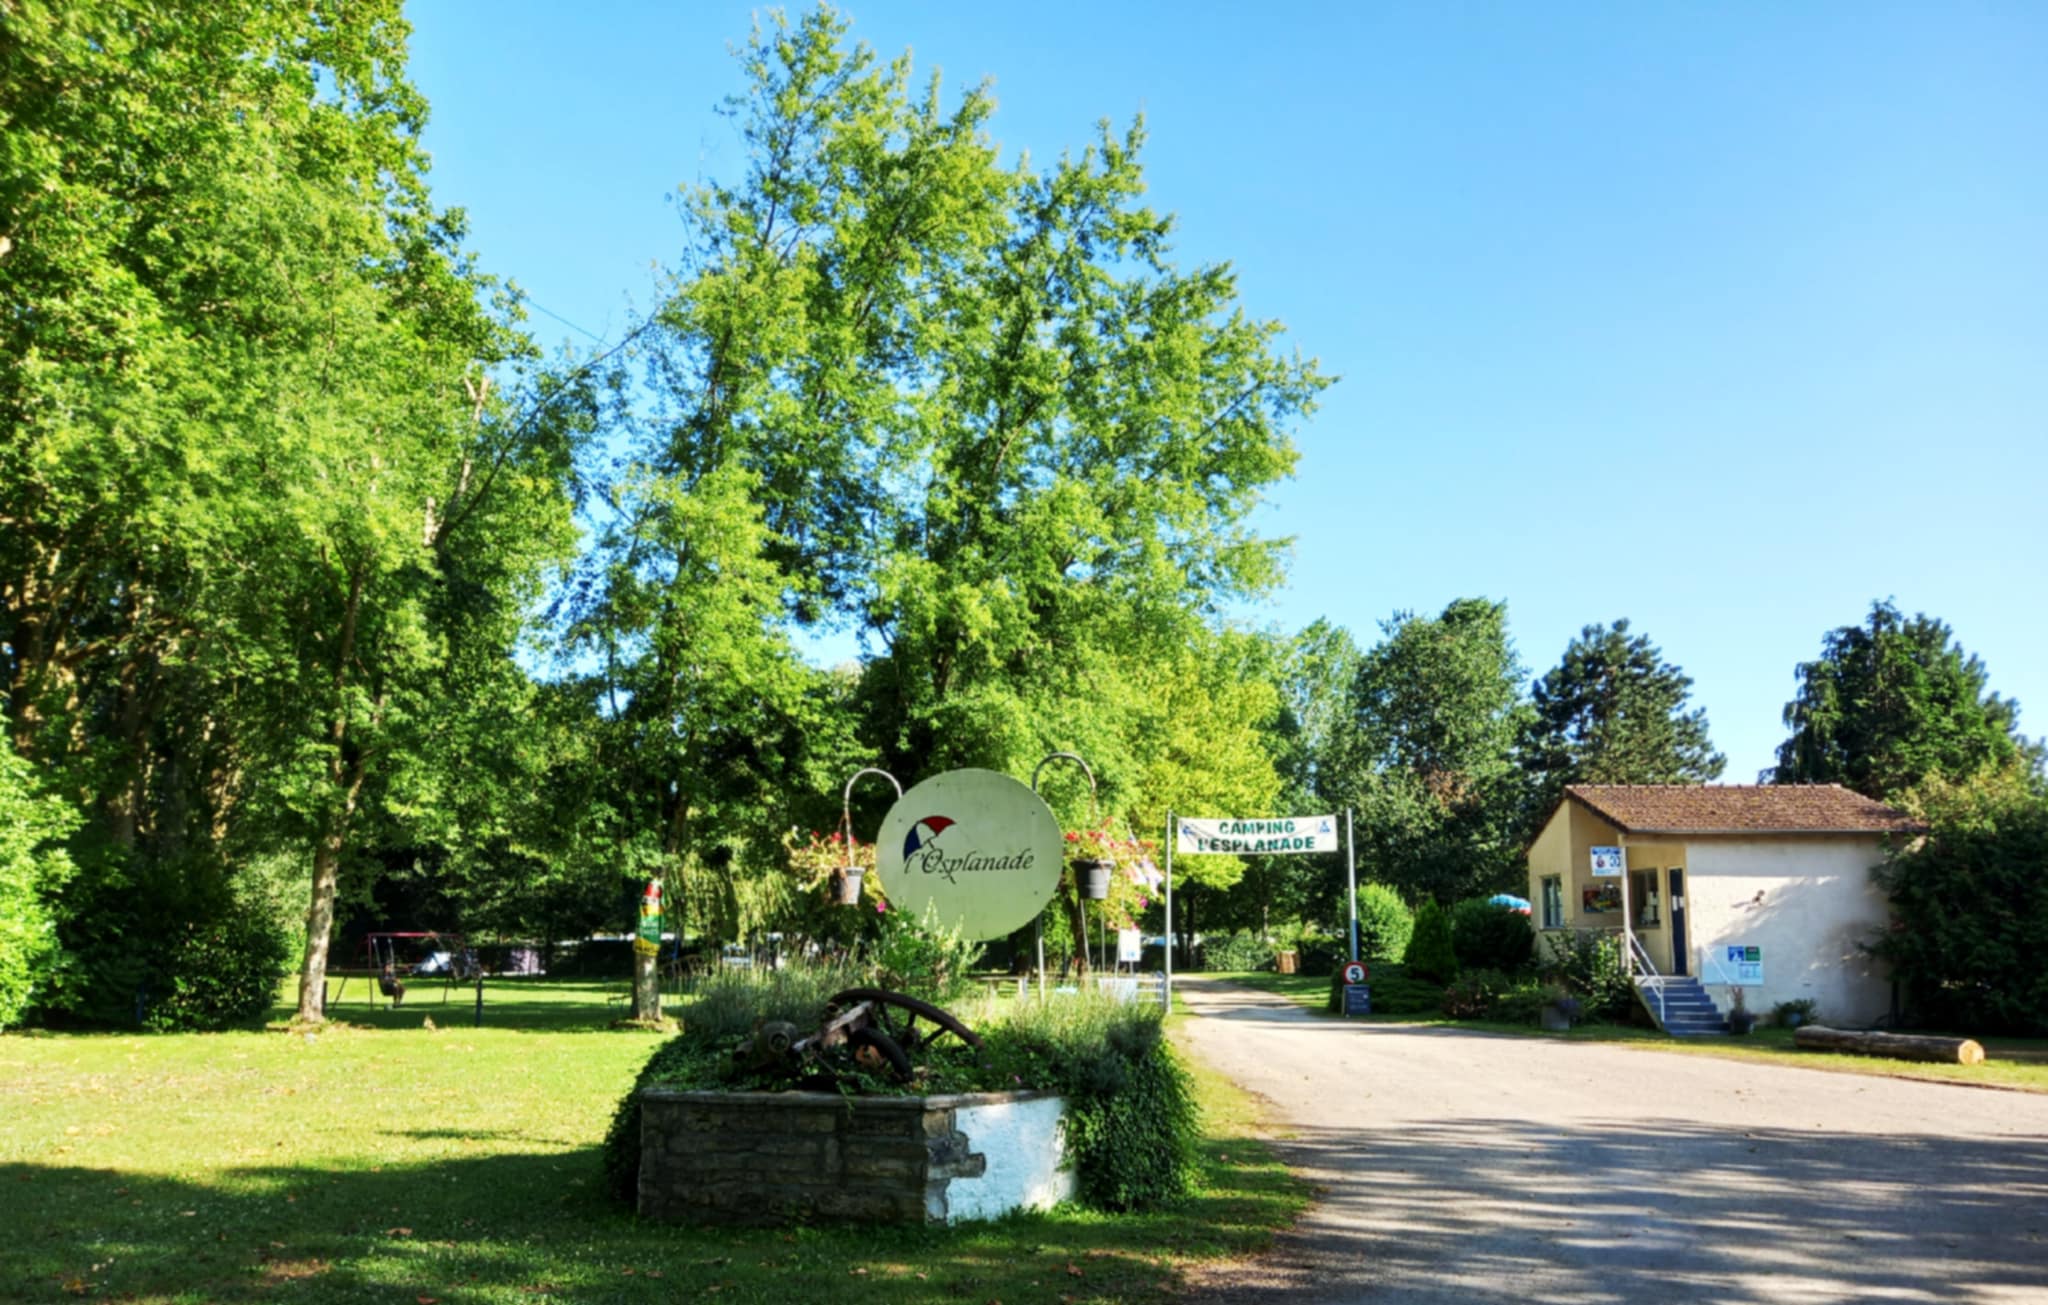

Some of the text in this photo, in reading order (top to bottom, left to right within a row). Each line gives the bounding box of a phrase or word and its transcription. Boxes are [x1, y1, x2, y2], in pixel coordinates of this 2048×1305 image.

[1219, 820, 1296, 835] CAMPING
[1198, 836, 1316, 851] L'ESPLANADE
[1350, 967, 1360, 981] 5
